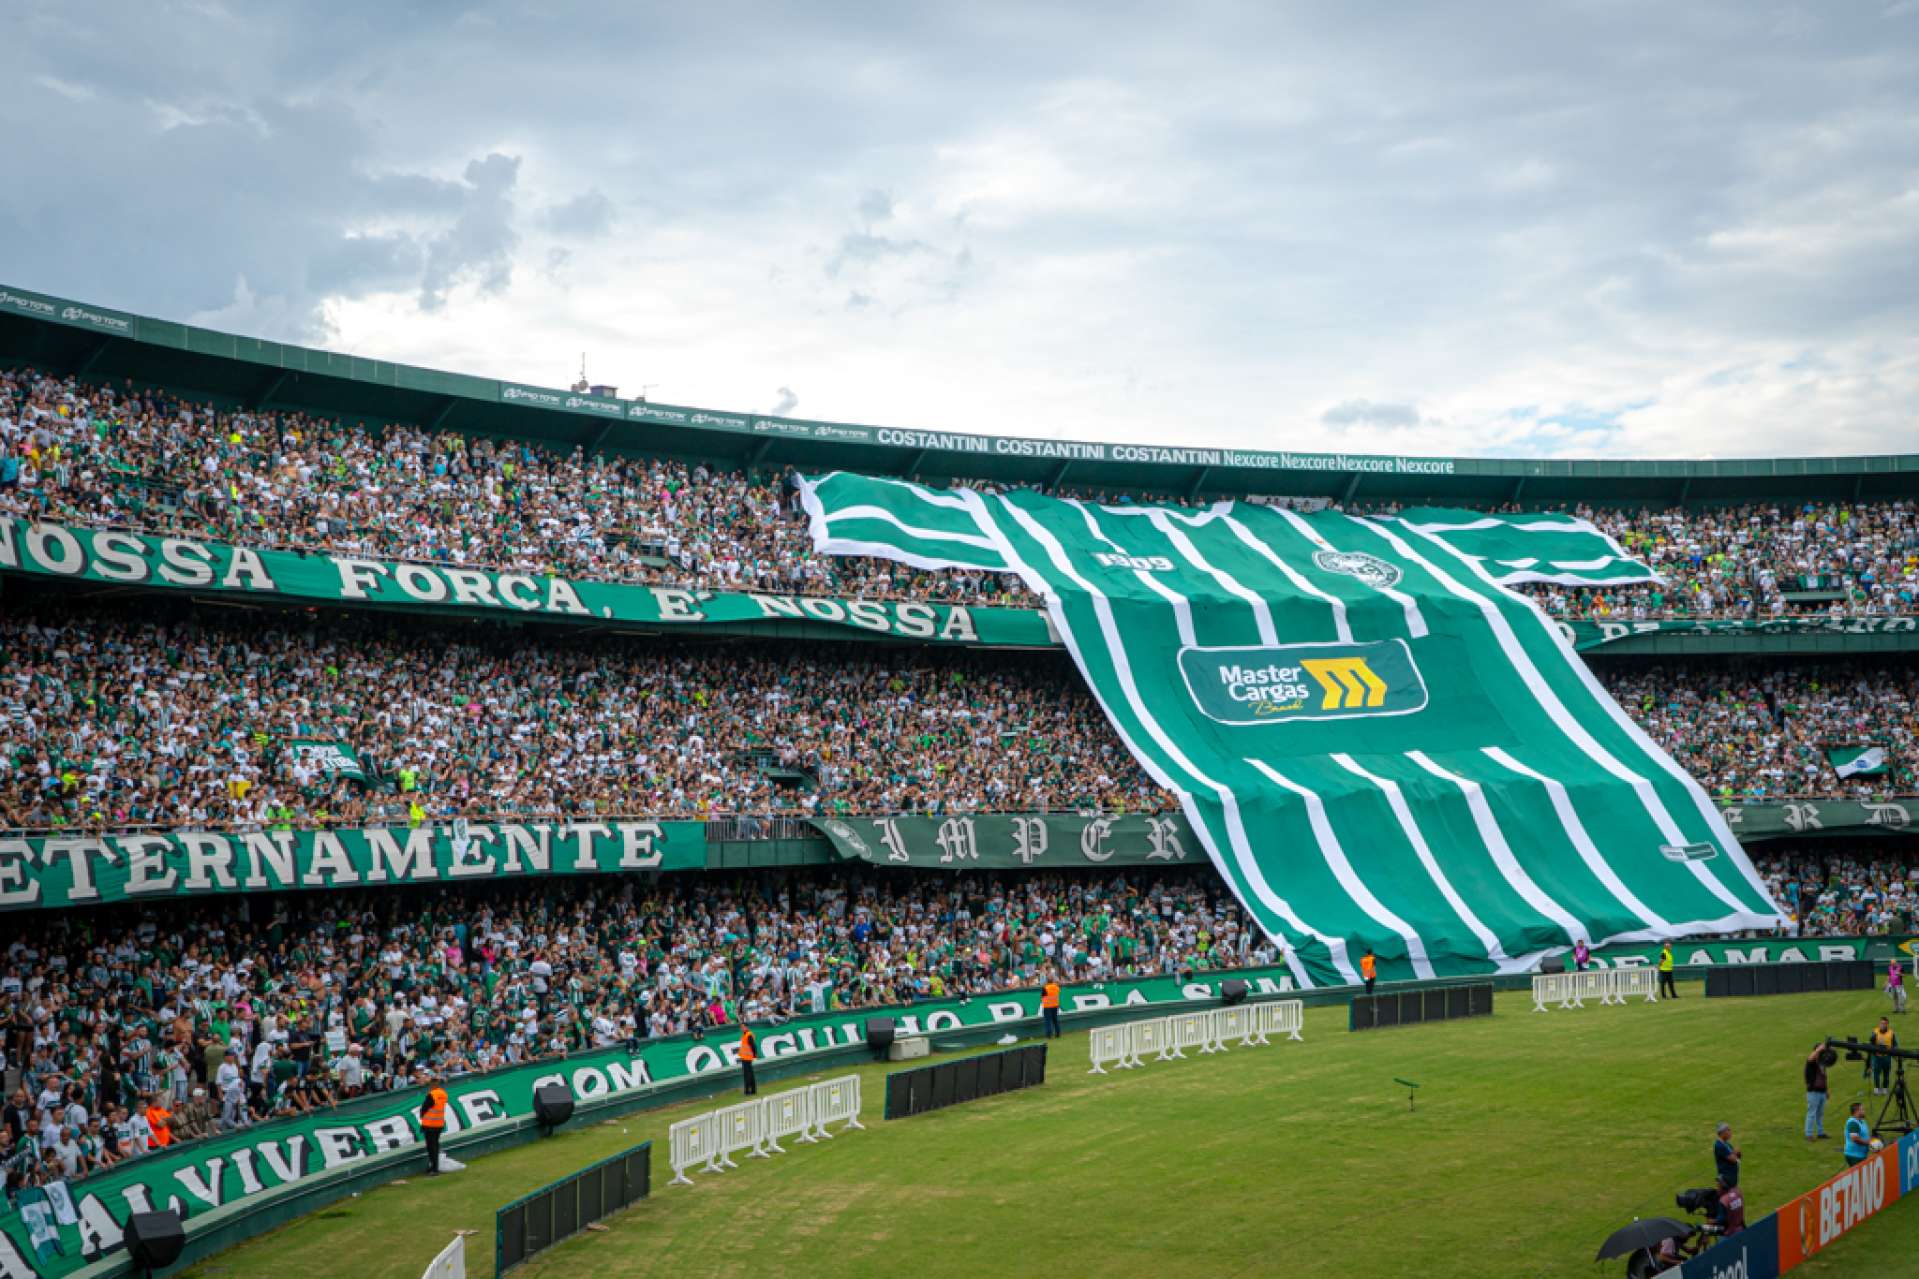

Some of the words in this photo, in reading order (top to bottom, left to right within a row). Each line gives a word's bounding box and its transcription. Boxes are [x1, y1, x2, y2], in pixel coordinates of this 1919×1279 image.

[878, 428, 988, 452] COSTANTINI
[996, 438, 1105, 460] COSTANTINI
[1112, 445, 1221, 465] COSTANTINI
[1223, 451, 1279, 468] Nexcore
[1281, 453, 1336, 471] Nexcore
[1336, 454, 1393, 473] Nexcore
[1396, 456, 1455, 474] Nexcore
[748, 593, 977, 640] NOSSA
[1219, 664, 1302, 684] Master
[1229, 681, 1309, 702] Cargas
[0, 823, 664, 903] ETERNAMENTE
[1820, 1156, 1885, 1246] BETANO
